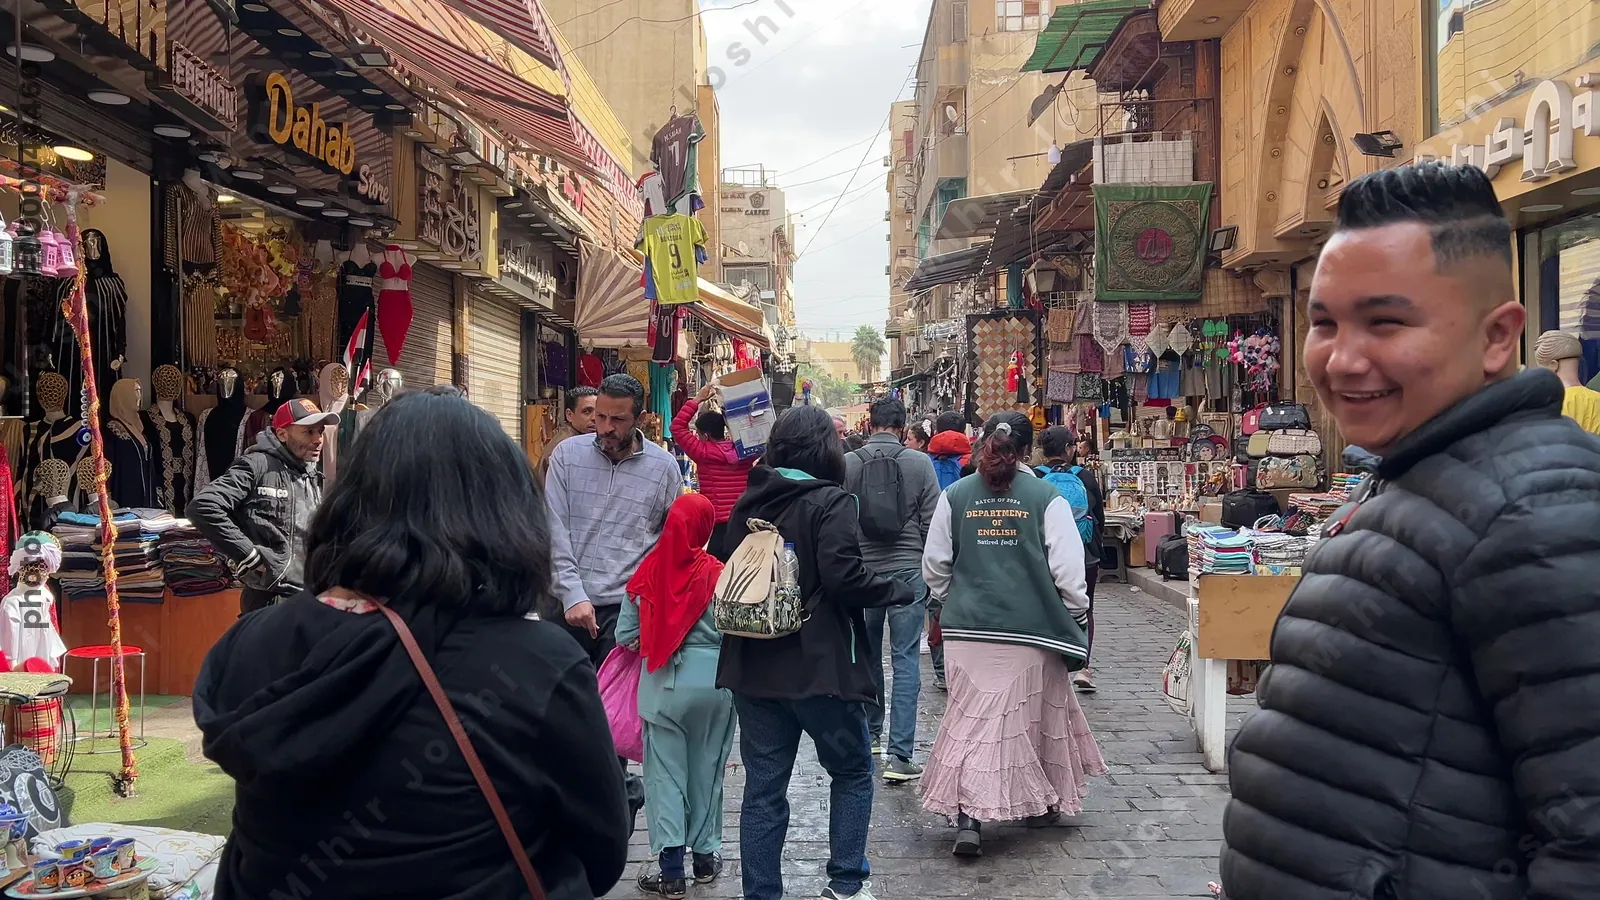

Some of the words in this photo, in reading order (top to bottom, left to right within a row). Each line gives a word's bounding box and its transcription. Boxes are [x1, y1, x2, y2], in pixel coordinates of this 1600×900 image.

[175, 51, 236, 122] FASHION
[266, 73, 355, 175] Dahab
[358, 164, 390, 204] Store
[669, 244, 681, 269] 9
[966, 509, 1030, 519] DEPARTMENT
